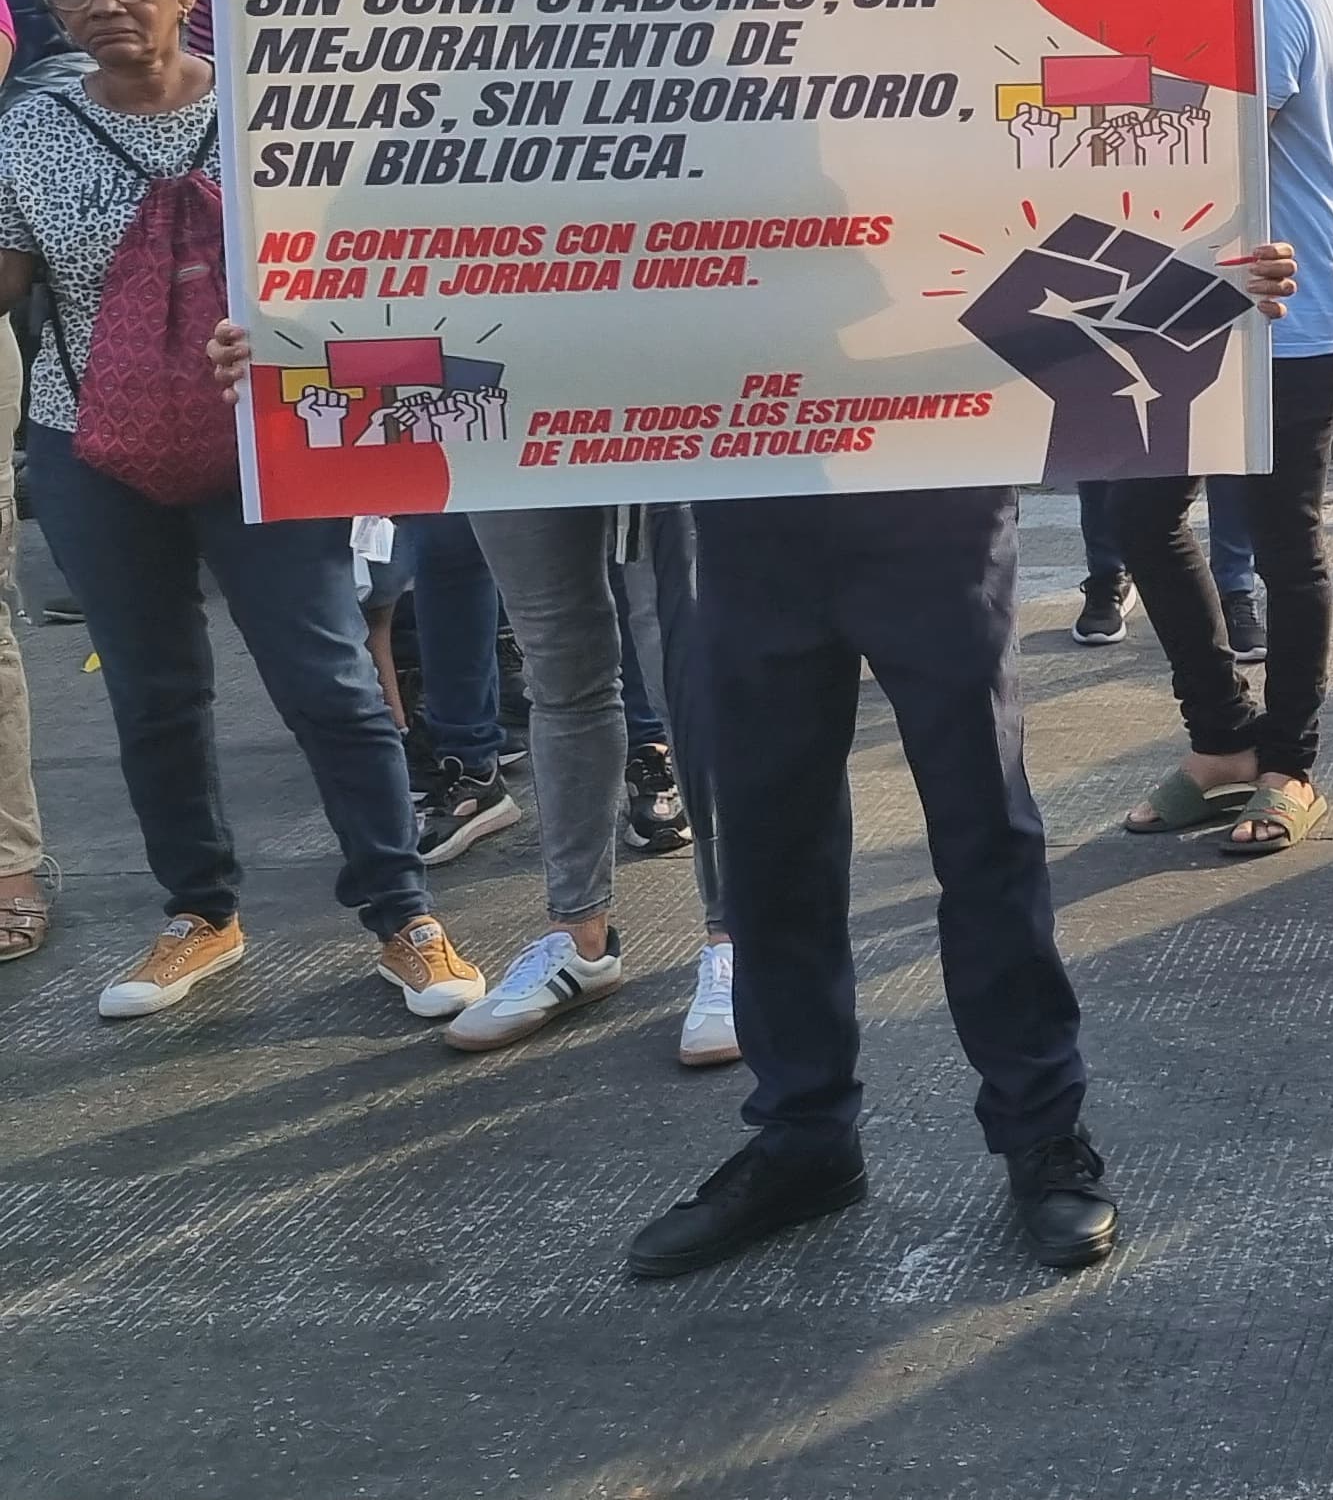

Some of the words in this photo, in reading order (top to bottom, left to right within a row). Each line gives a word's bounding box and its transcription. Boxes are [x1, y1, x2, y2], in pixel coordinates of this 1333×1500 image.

[246, 20, 715, 75] MEJORAMIENTO
[726, 20, 803, 67] DE
[247, 83, 458, 134] AULAS,
[471, 80, 574, 128] SIN
[583, 73, 974, 126] LABORATORIO,
[253, 141, 356, 188] SIN
[364, 133, 704, 187] BIBLIOTECA.
[257, 231, 318, 264] NO
[326, 225, 545, 262] CONTAMOS
[556, 222, 637, 257] CON
[645, 215, 893, 253] CONDICIONES
[258, 267, 369, 302] PARA
[377, 266, 426, 299] LA
[438, 258, 621, 296] JORNADA
[633, 255, 760, 291] UNICA.
[740, 372, 803, 399] PAE
[528, 408, 613, 437] PARA
[623, 403, 723, 433] TODOS
[728, 400, 789, 429] LOS
[794, 392, 993, 427] ESTUDIANTES
[518, 440, 558, 468] DE
[567, 433, 703, 466] MADRES
[710, 426, 875, 460] CATOLICAS
